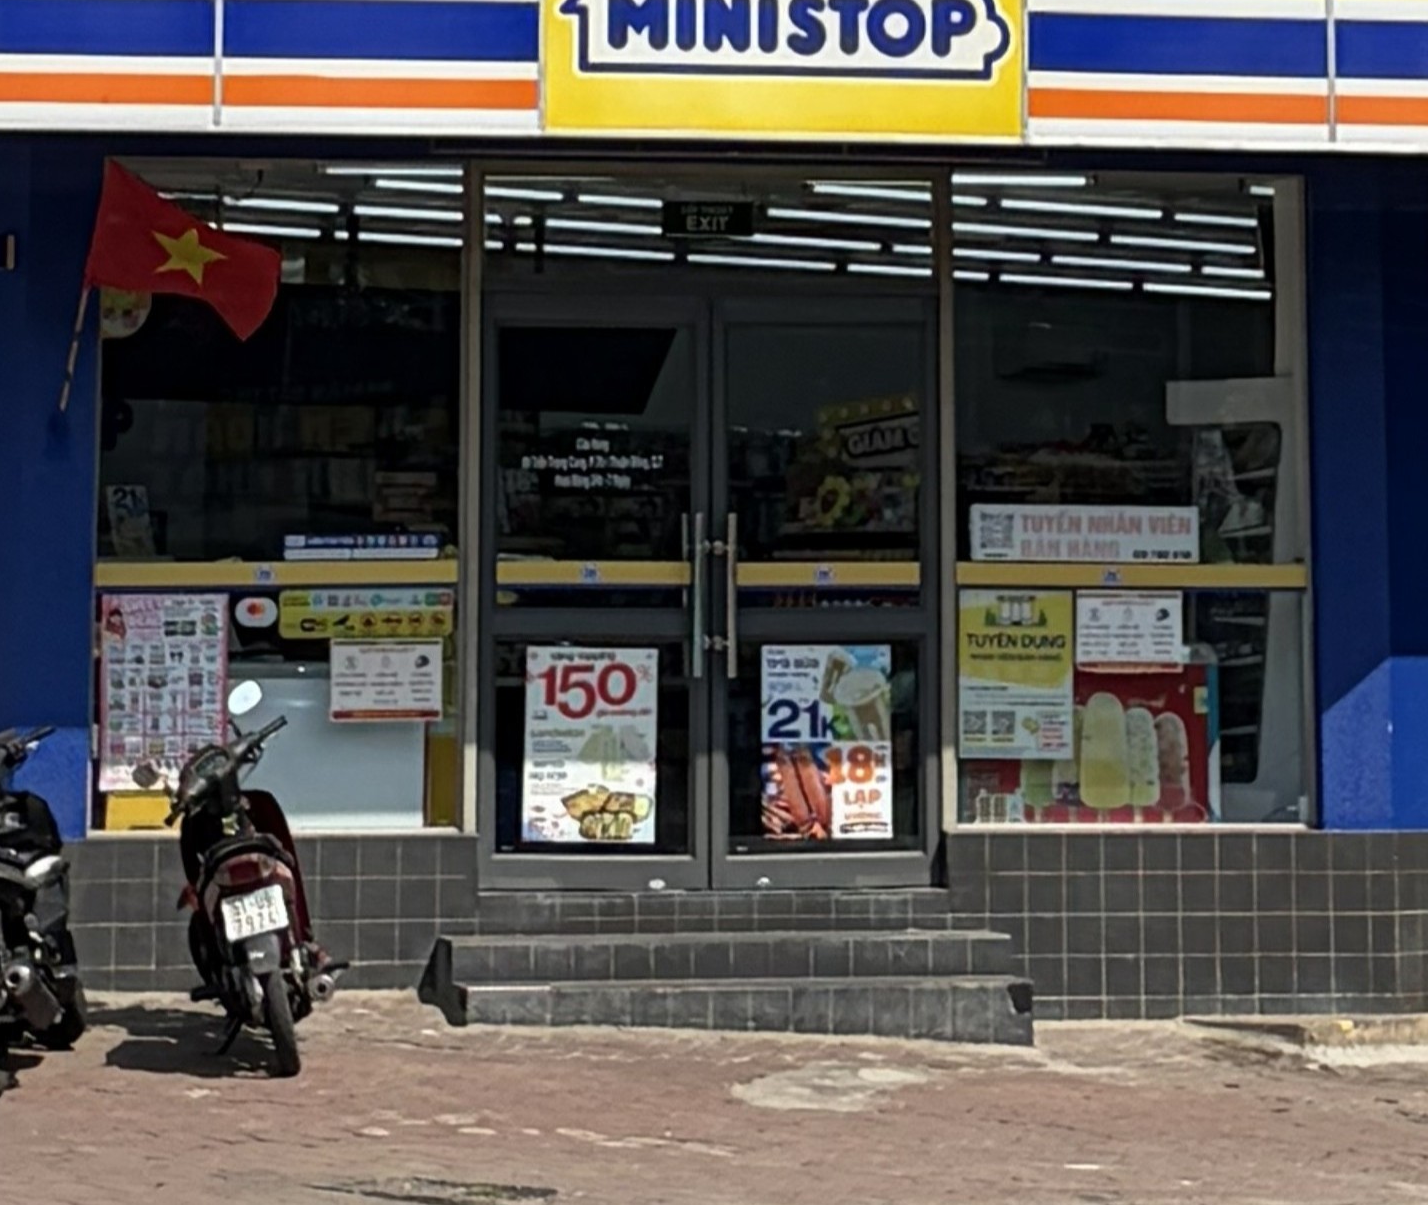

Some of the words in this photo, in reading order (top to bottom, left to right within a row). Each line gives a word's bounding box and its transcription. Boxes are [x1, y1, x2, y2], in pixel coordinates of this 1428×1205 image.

[686, 216, 729, 231] EXIT
[1020, 511, 1082, 534] TUYỂN
[1087, 512, 1142, 535] NHÂN
[1148, 513, 1192, 535] VIÊN
